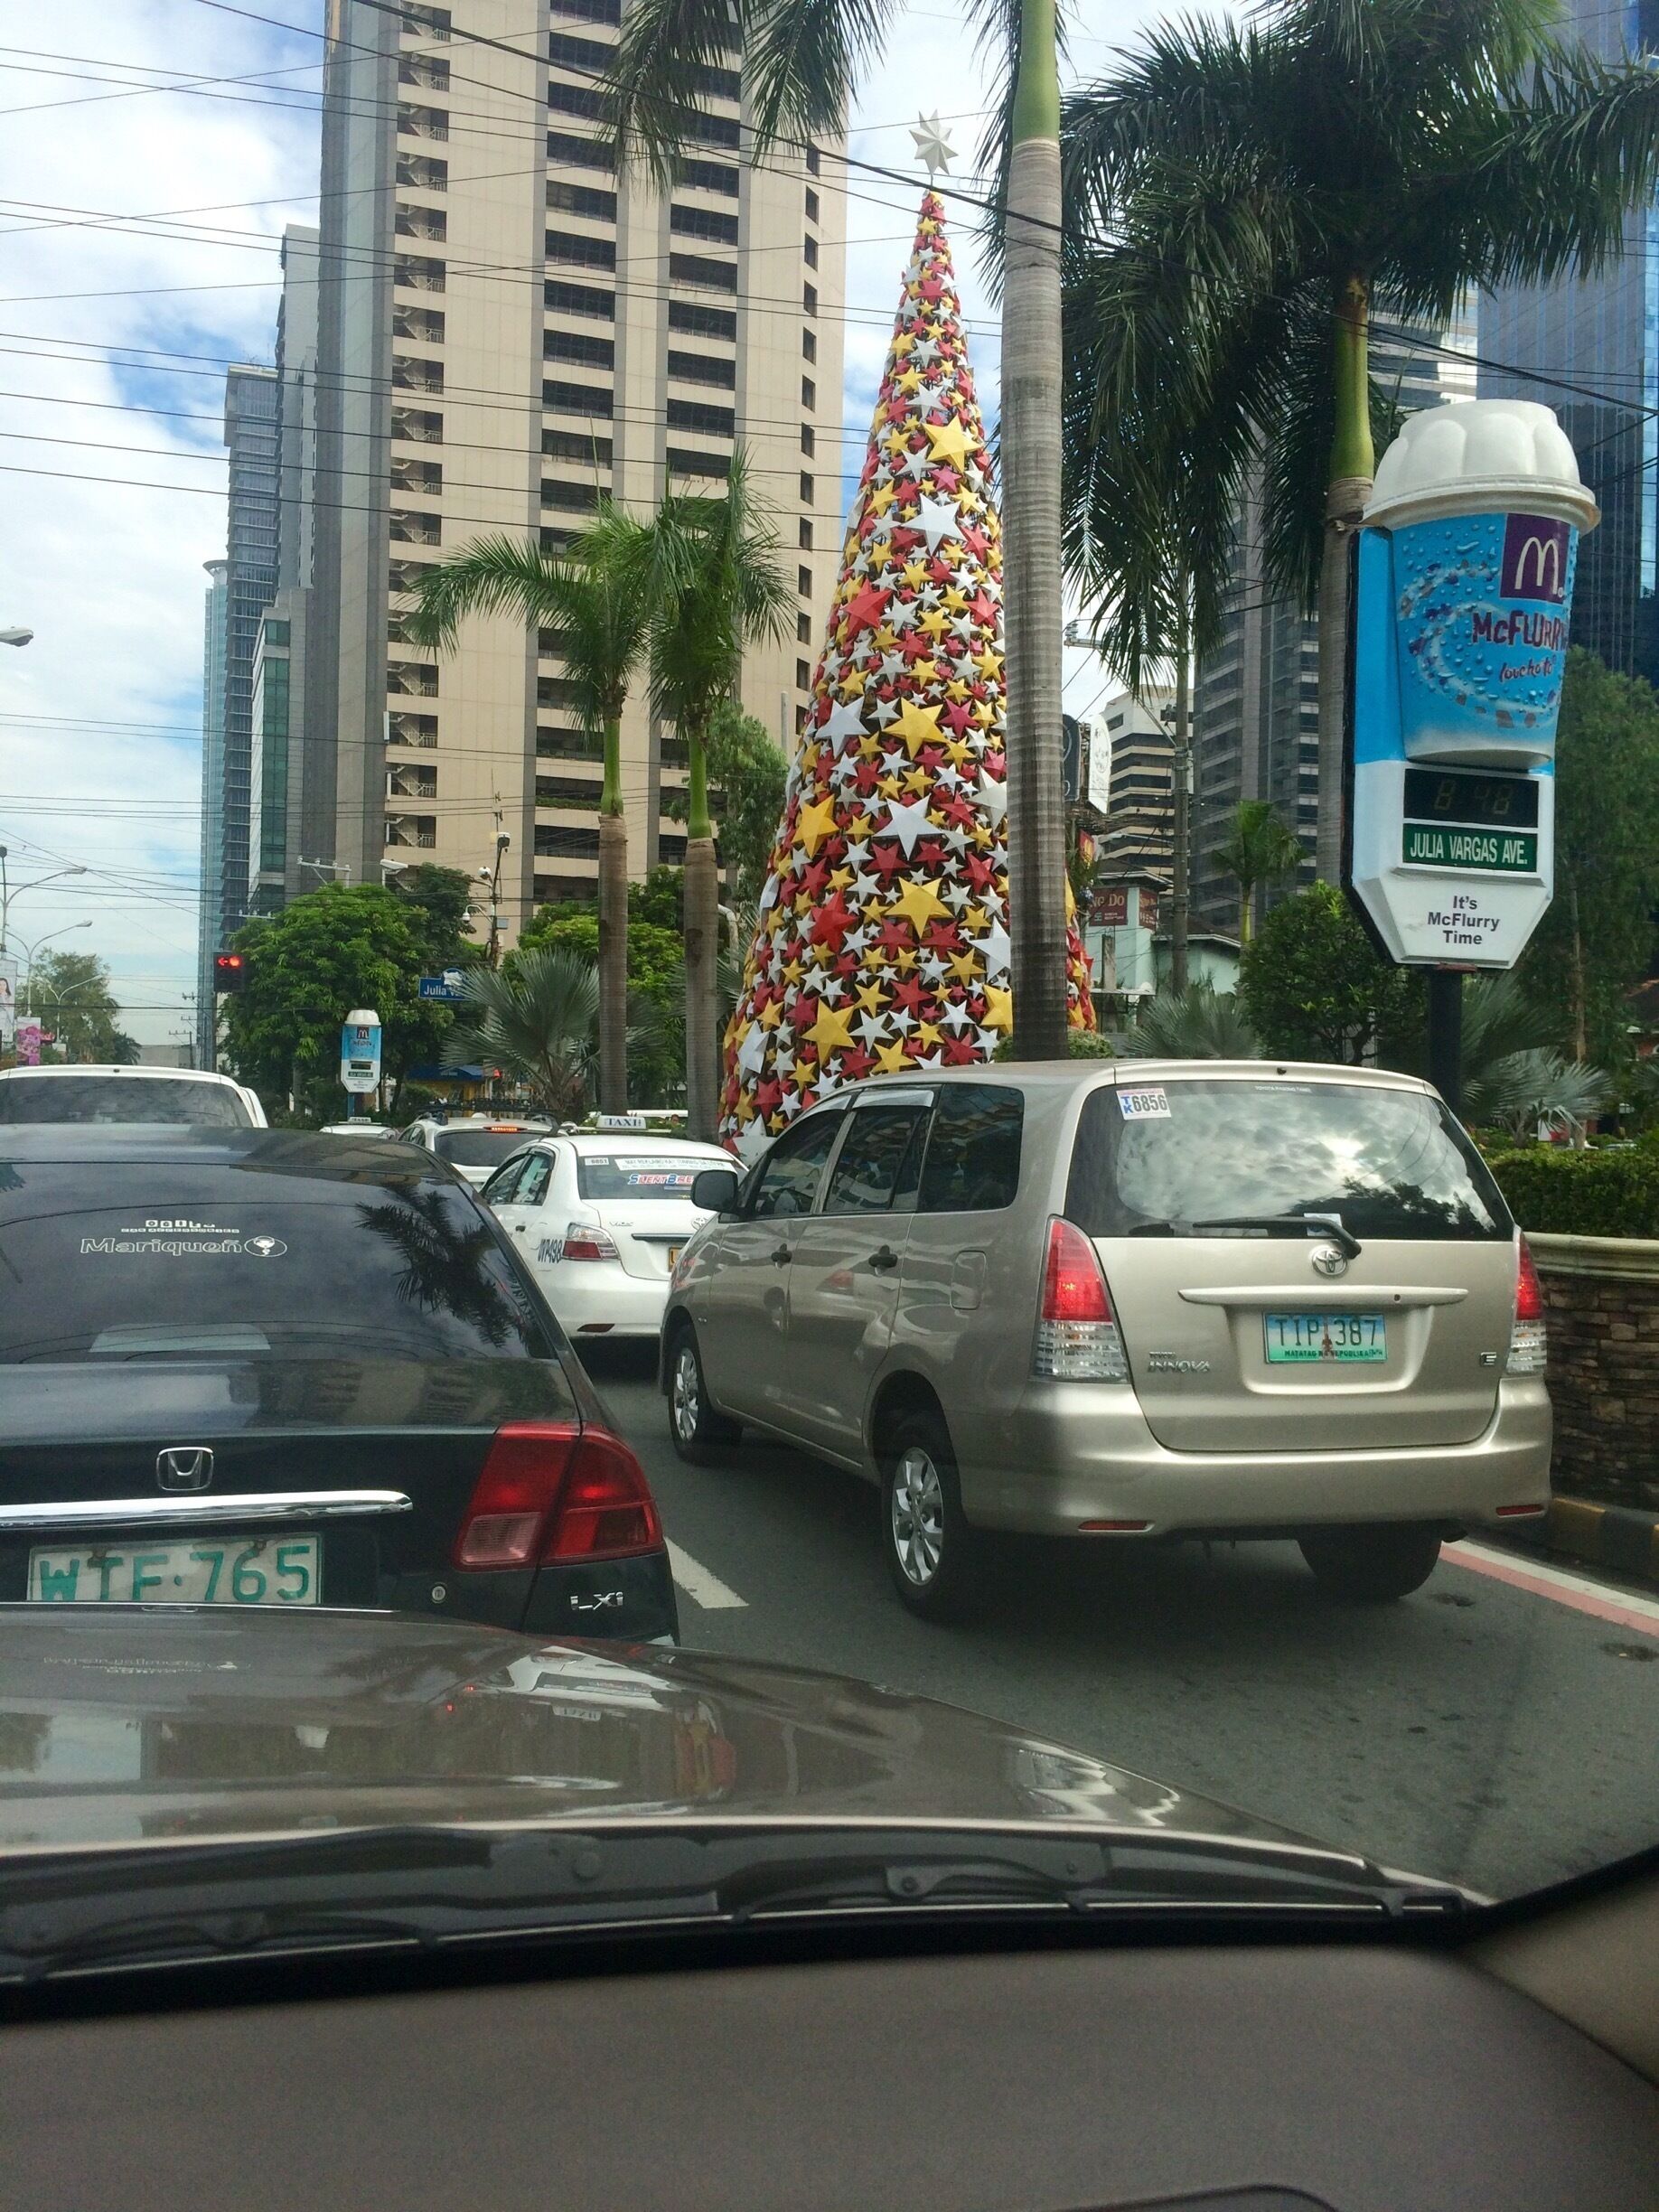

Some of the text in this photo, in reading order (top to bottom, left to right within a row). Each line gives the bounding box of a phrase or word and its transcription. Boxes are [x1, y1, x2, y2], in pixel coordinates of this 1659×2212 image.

[1410, 832, 1528, 865] JULIA VARGAS AVE.
[1453, 895, 1478, 910] It's
[1428, 912, 1500, 932] McFlurry
[1443, 930, 1483, 944] Time
[423, 984, 447, 997] Julia
[1131, 1094, 1167, 1111] 6856
[607, 1117, 637, 1127] TAXI
[1334, 1319, 1377, 1345] 387
[1148, 1361, 1209, 1373] INNOVA
